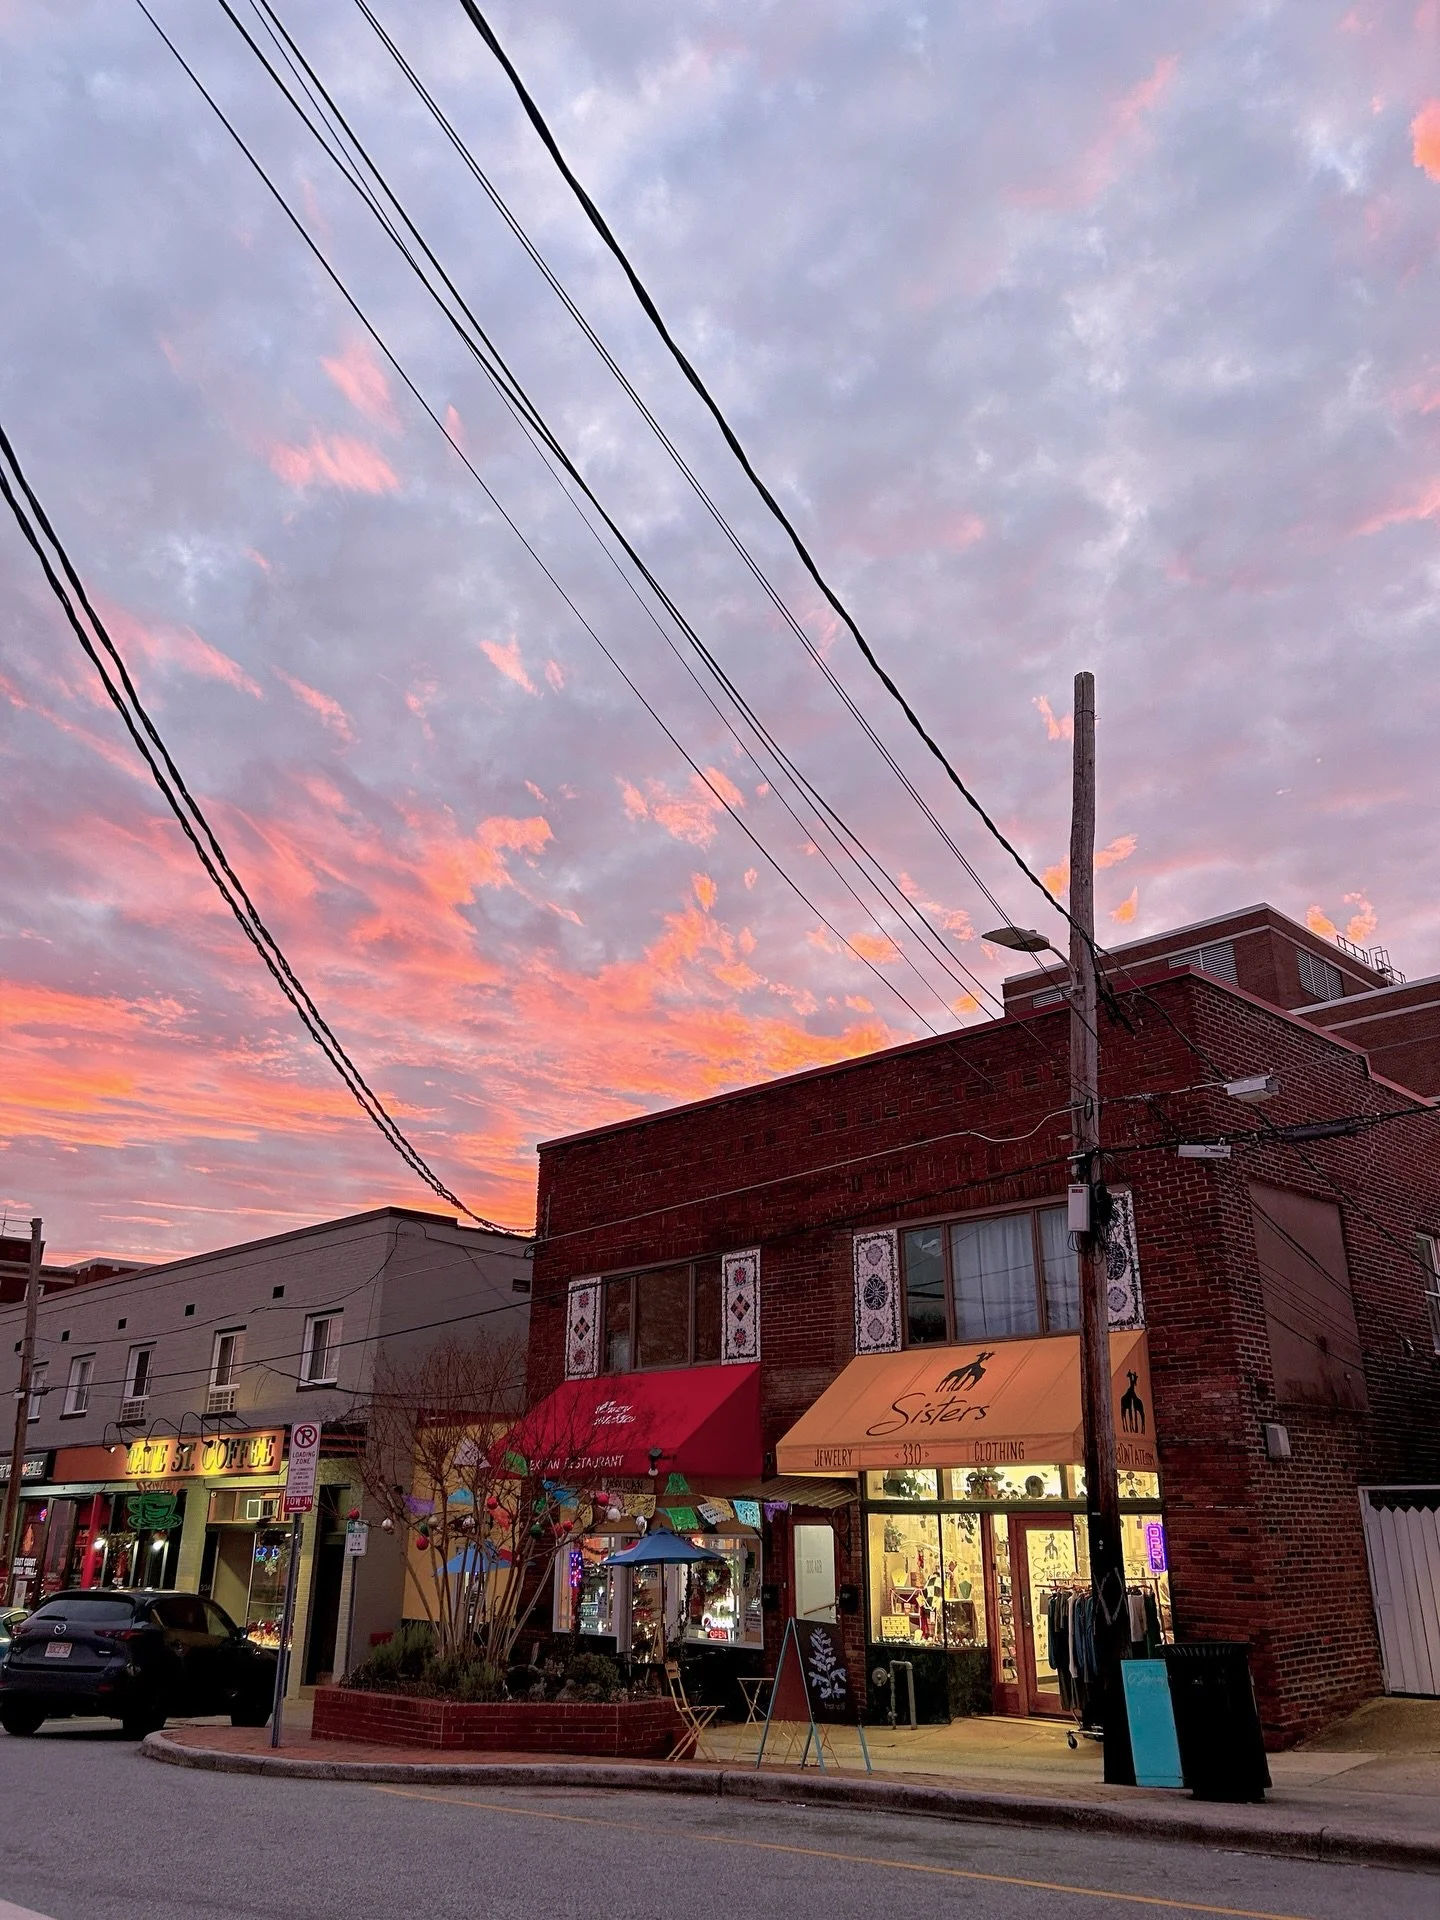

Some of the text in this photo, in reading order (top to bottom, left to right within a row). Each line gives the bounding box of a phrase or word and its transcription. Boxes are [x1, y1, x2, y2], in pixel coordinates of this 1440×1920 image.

[865, 1391, 991, 1436] Sisters
[125, 1442, 169, 1475] TATE
[201, 1436, 277, 1471] COFFEE
[292, 1451, 316, 1460] LOADING
[295, 1458, 311, 1466] ZONE
[813, 1448, 853, 1467] JEWELRY
[902, 1443, 923, 1466] 330
[974, 1440, 1025, 1463] CLOTHING
[286, 1496, 312, 1506] TOW-IN
[1149, 1526, 1164, 1571] OPEN
[709, 1629, 728, 1639] OPEN
